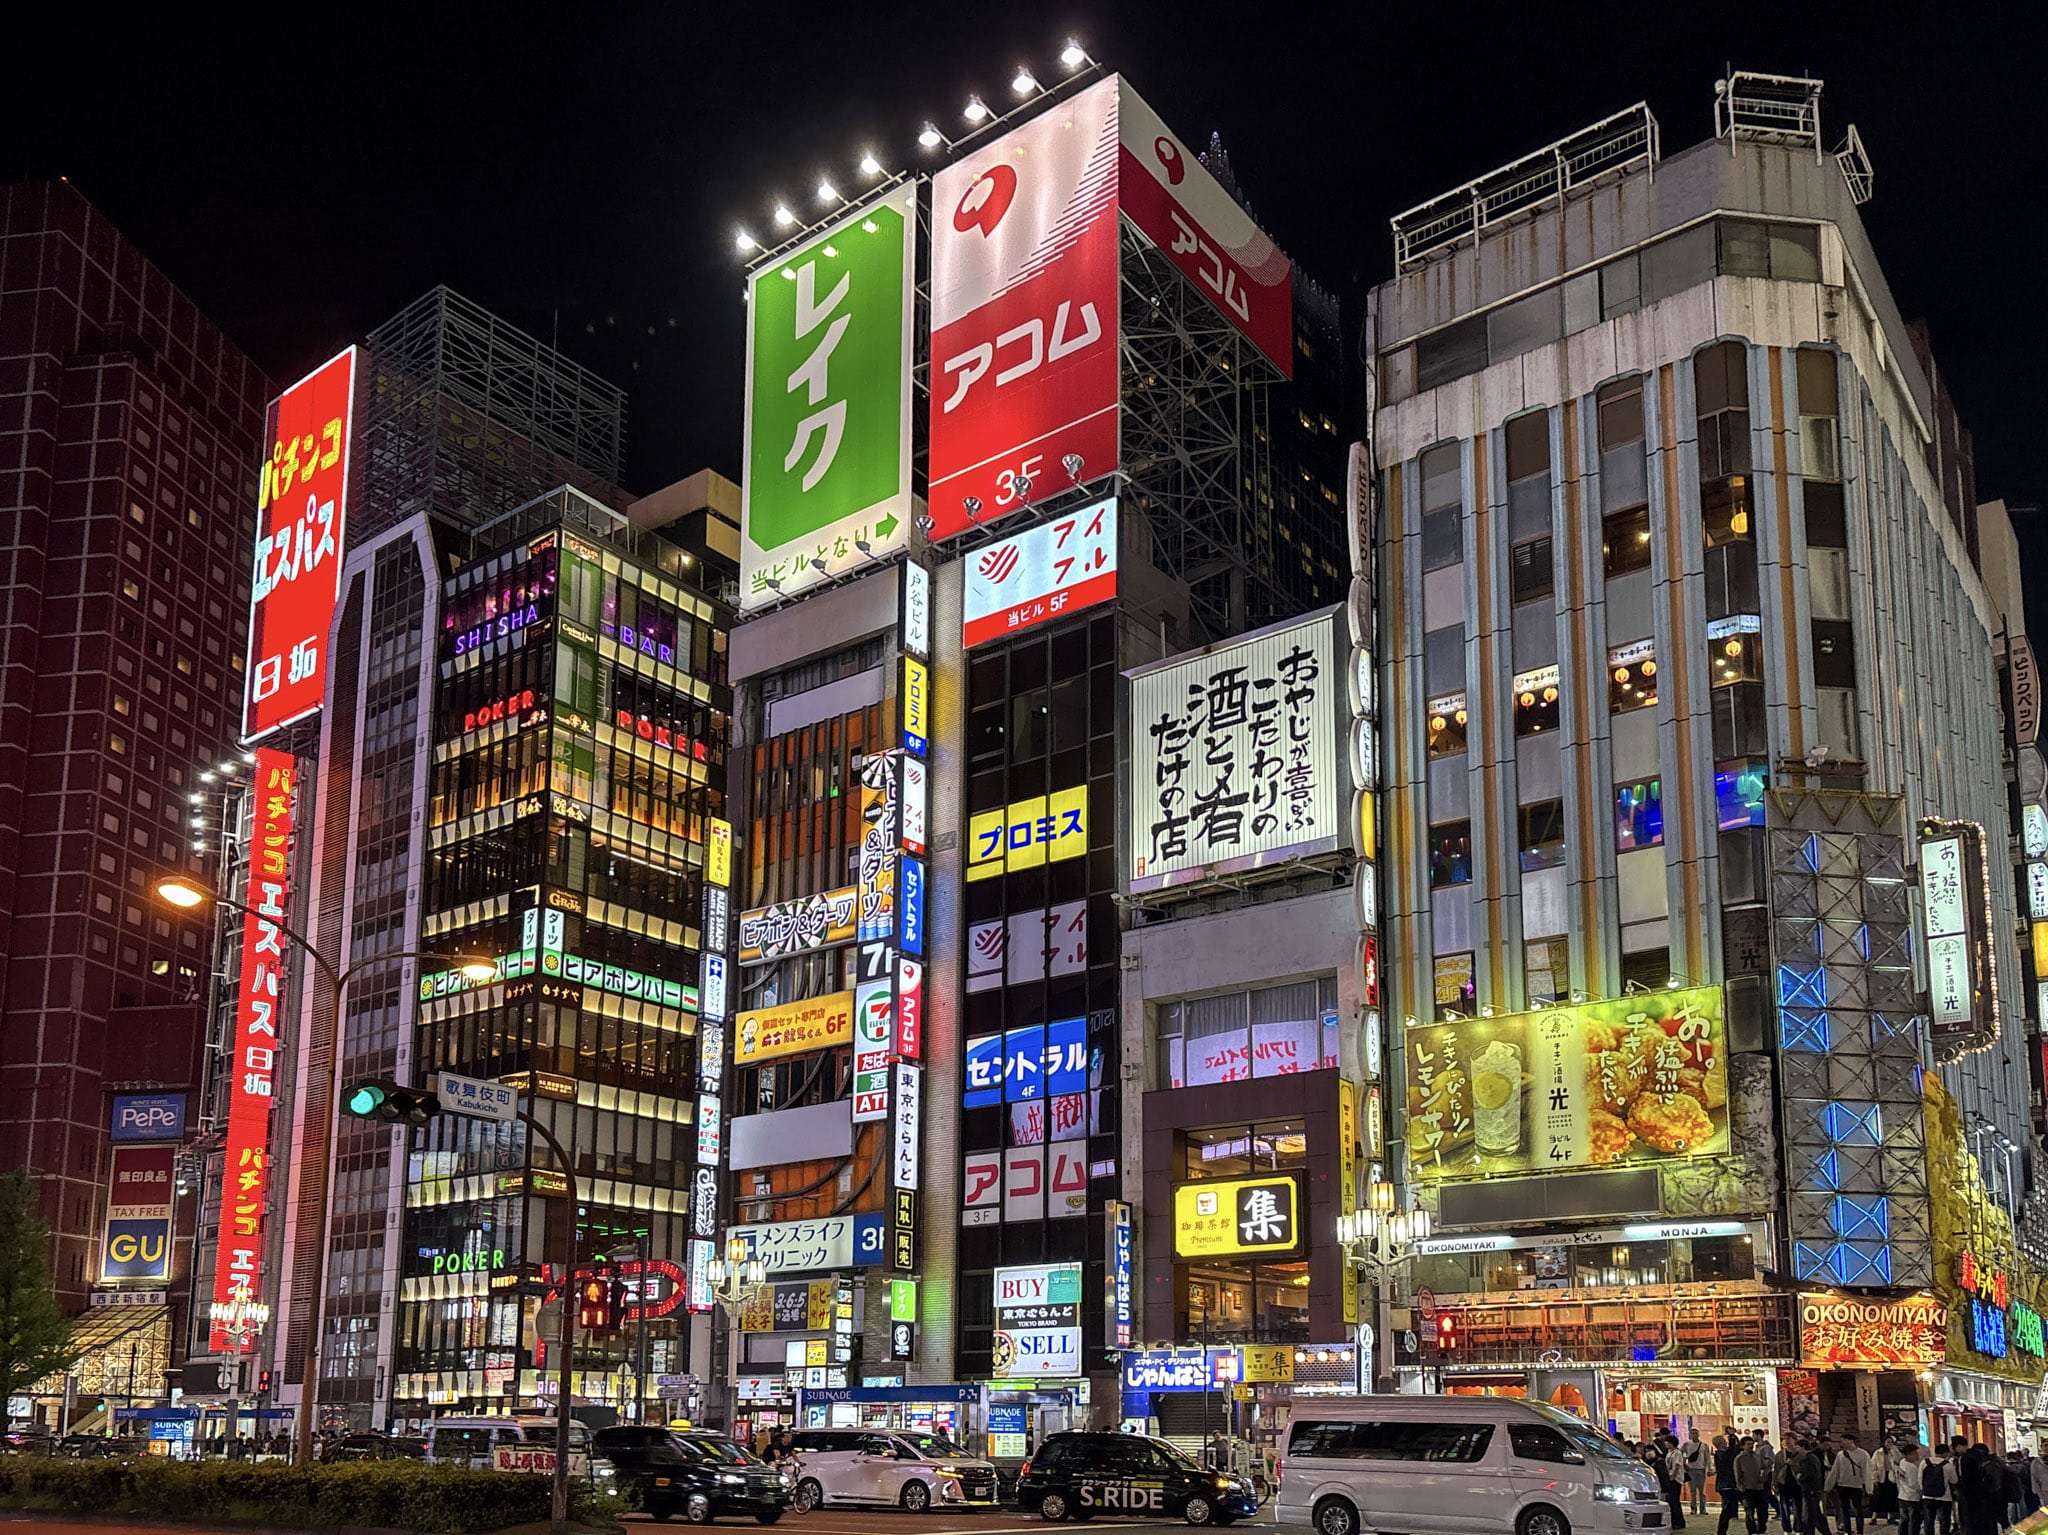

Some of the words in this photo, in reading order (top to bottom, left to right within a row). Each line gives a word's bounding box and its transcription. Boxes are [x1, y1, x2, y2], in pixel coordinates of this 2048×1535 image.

[1170, 209, 1248, 323] アコム
[944, 300, 1101, 414] アコム
[785, 260, 851, 493] レイク
[260, 417, 341, 509] パチンコ
[994, 454, 1044, 505] 3F
[253, 493, 334, 602] エスパス
[1008, 603, 1044, 627] 当ビル
[1050, 592, 1068, 612] 5F
[455, 604, 538, 654] SHISHA
[622, 625, 672, 664] BAR
[253, 635, 317, 702] 日拓
[464, 690, 534, 732] POKER
[910, 669, 921, 729] プロミス
[617, 710, 706, 762] POKER
[908, 736, 921, 750] 6F
[1149, 713, 1191, 864] だけの店
[979, 808, 1083, 858] プロミス
[906, 870, 917, 941] セントラル
[526, 910, 535, 945] ダーツ
[548, 912, 559, 945] ダーツ
[863, 943, 892, 977] 7
[565, 956, 680, 1002] ビアポンバー
[1436, 986, 1460, 1003] 4F
[1943, 995, 1959, 1011] 光
[826, 1013, 847, 1034] 6F
[903, 997, 916, 1042] アコム
[903, 1043, 914, 1054] 3F
[1624, 1013, 1648, 1079] チキンが
[967, 1042, 1087, 1087] セントラル
[1554, 1043, 1562, 1083] チキン酒場
[1654, 1040, 1684, 1105] 猛烈に
[446, 1078, 510, 1105] 歌舞伎町
[703, 1077, 720, 1092] 7F
[870, 1075, 887, 1091] 酒
[1021, 1086, 1035, 1097] 4F
[457, 1098, 498, 1114] Kabukicho
[859, 1094, 887, 1112] AT
[1415, 1043, 1444, 1167] レモンサワー
[1549, 1087, 1569, 1111] 光
[122, 1107, 176, 1127] PePe
[1550, 1144, 1572, 1161] 4F
[119, 1171, 167, 1183] 無印良品
[966, 1154, 1086, 1205] アコム
[114, 1207, 134, 1217] TAX
[139, 1207, 166, 1216] FREE
[973, 1211, 991, 1223] 3F
[1240, 1189, 1287, 1241] 集
[760, 1222, 844, 1246] メンズライフ
[1660, 1226, 1710, 1238] MONJA
[110, 1234, 164, 1263] GU
[761, 1247, 827, 1268] クリニック
[1427, 1241, 1496, 1253] OKONOMIYAKI
[434, 1250, 504, 1273] POKER
[96, 1293, 160, 1304] 西武新宿駅
[898, 1284, 906, 1314] レイク
[1002, 1278, 1046, 1298] BUY
[1804, 1305, 1948, 1327] OKONOMIYAKI
[1020, 1335, 1074, 1355] SELL
[1813, 1327, 1937, 1351] お好み焼き
[1270, 1352, 1291, 1376] 集
[807, 1391, 852, 1400] SUBNADE
[155, 1444, 161, 1453] 3
[1080, 1486, 1164, 1509] S.RIDE
